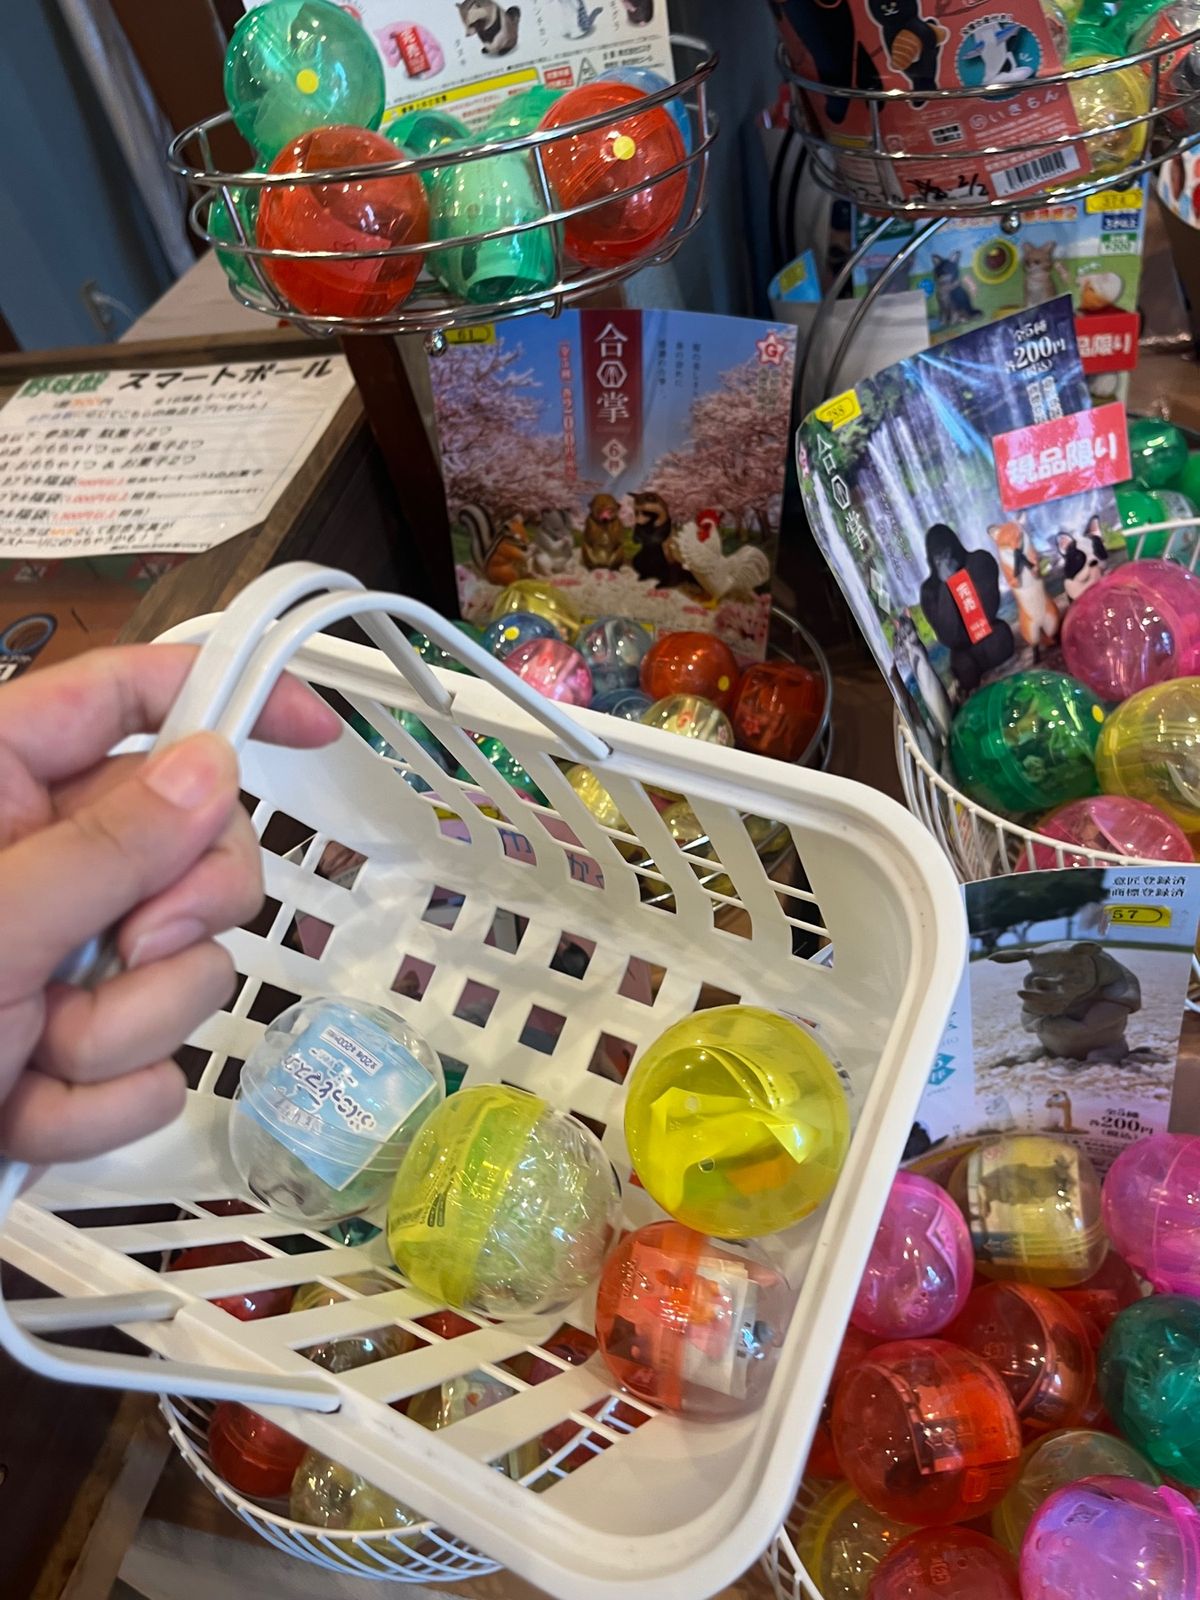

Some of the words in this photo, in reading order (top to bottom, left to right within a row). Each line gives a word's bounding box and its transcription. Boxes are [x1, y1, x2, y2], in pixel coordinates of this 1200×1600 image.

[119, 359, 333, 389] スマートボール
[1006, 433, 1117, 487] 現品限り
[1112, 875, 1186, 886] 意匠登録済
[1111, 887, 1185, 898] 商標登録済
